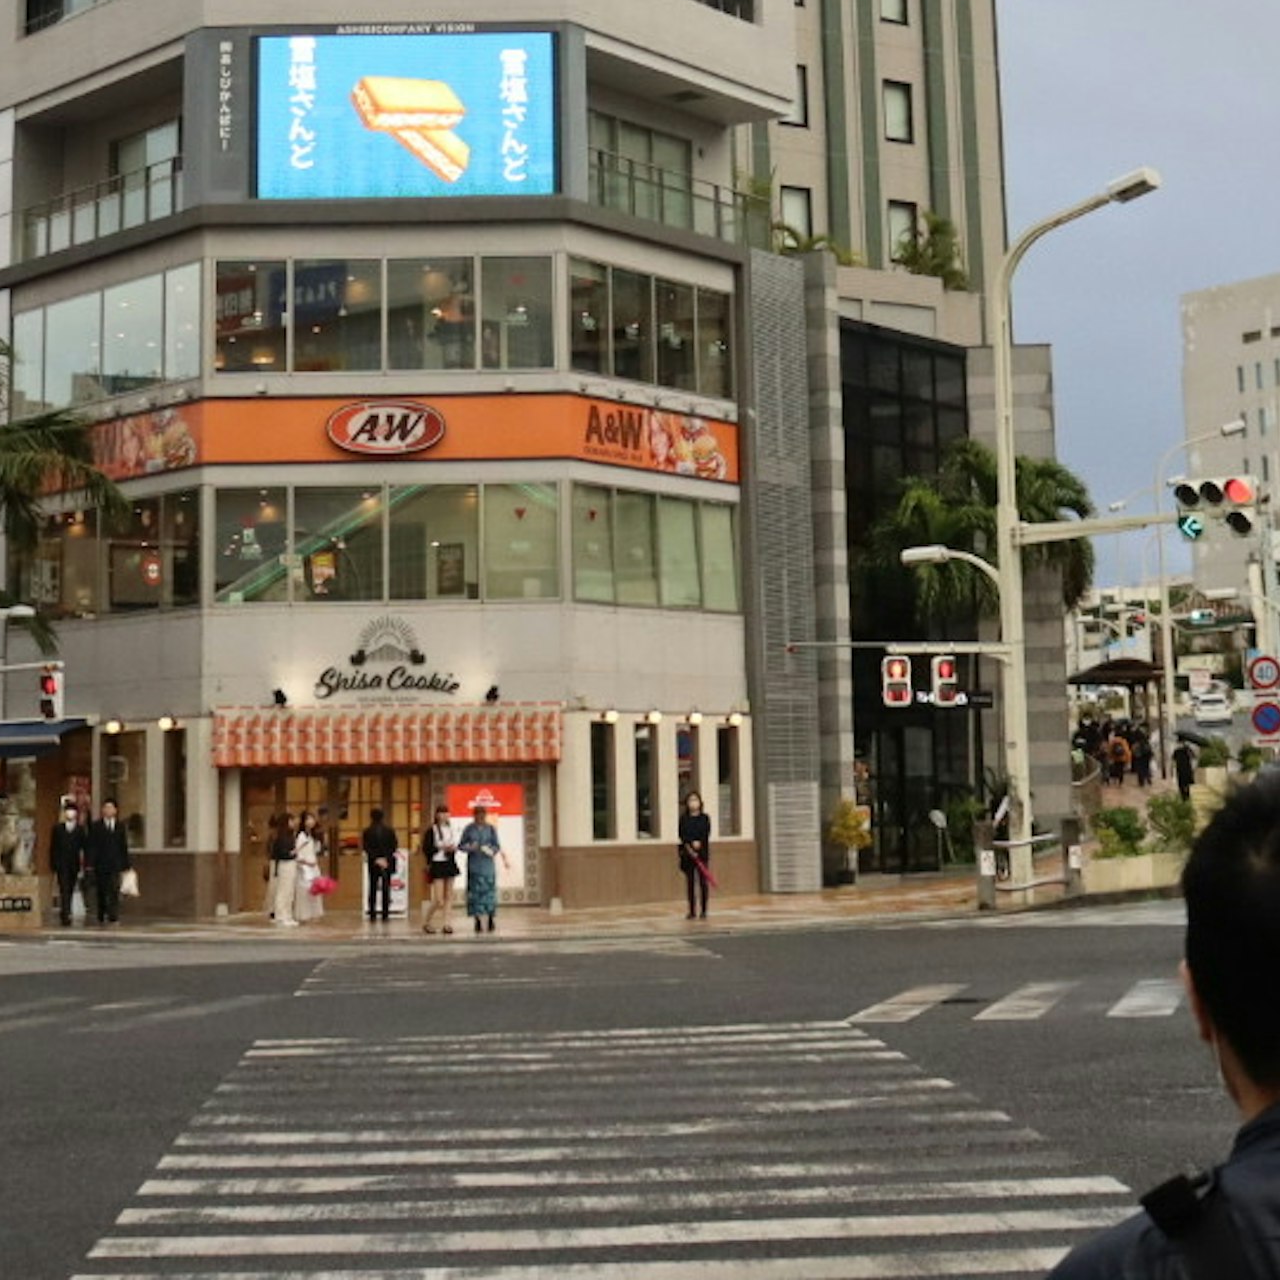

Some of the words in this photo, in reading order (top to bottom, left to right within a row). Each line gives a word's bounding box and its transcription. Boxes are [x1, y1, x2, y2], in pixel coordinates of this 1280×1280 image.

[435, 23, 475, 32] VISION
[351, 412, 424, 442] A&W
[585, 404, 644, 451] A&W
[314, 667, 382, 700] Shisa
[386, 666, 461, 695] Cookie
[1257, 666, 1275, 681] 40
